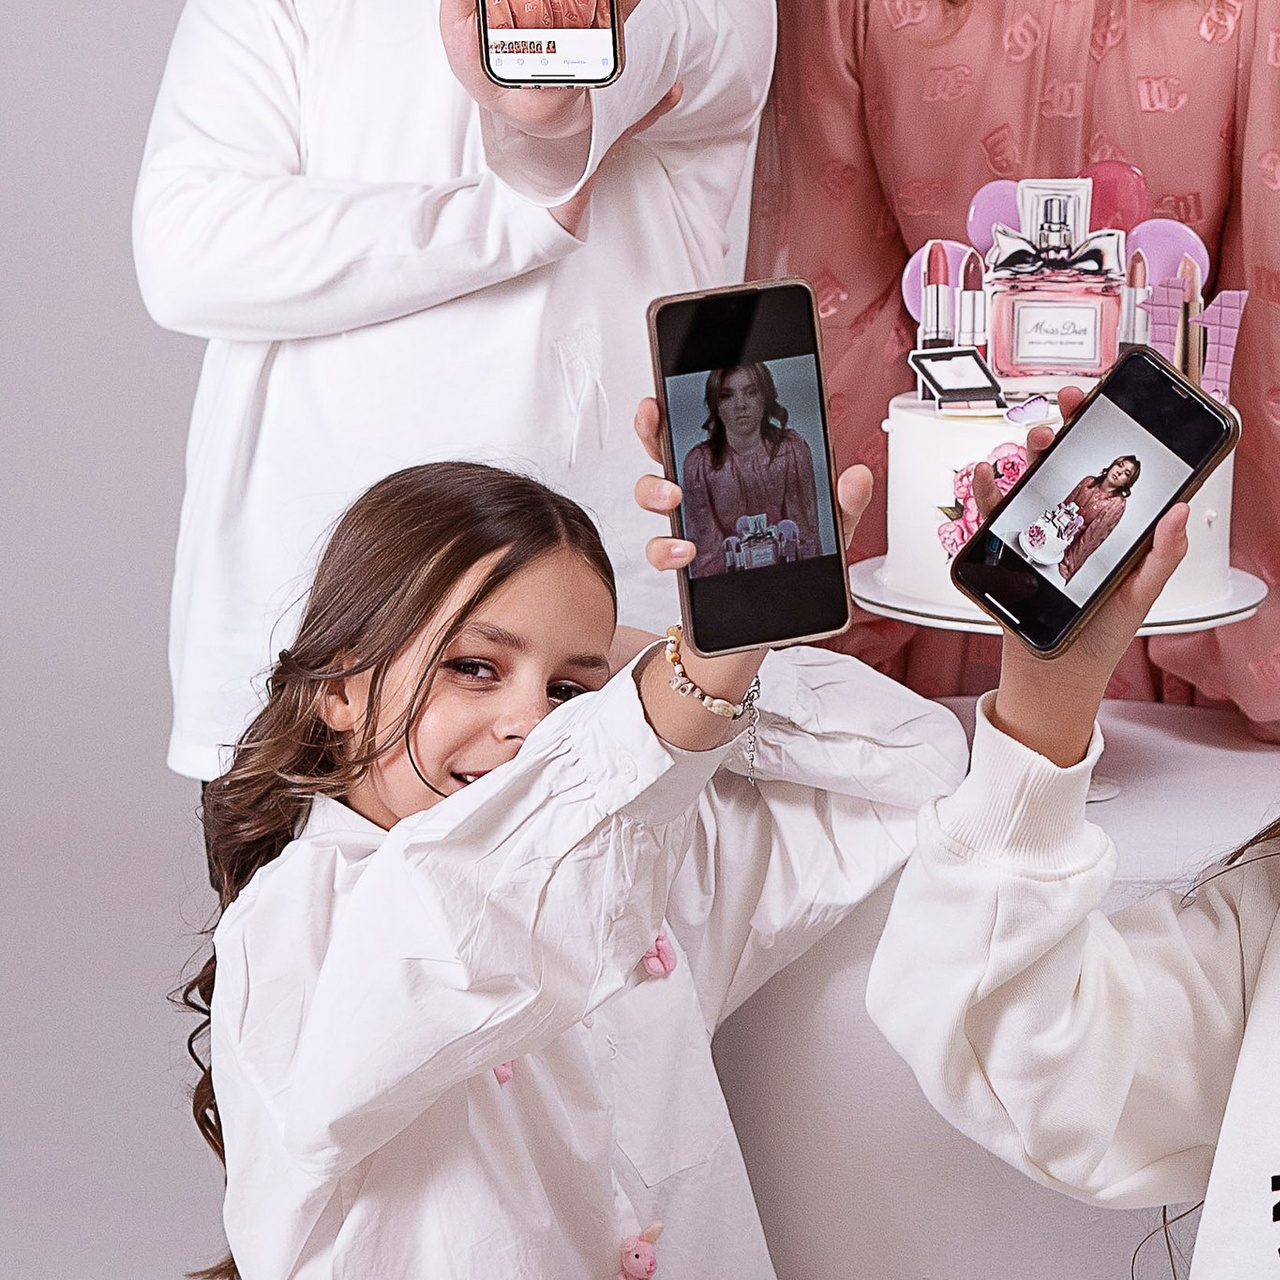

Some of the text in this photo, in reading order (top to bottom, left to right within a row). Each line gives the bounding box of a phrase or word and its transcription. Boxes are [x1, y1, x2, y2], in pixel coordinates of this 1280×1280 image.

[1137, 75, 1188, 113] DG
[1024, 321, 1088, 336] Miss Dior
